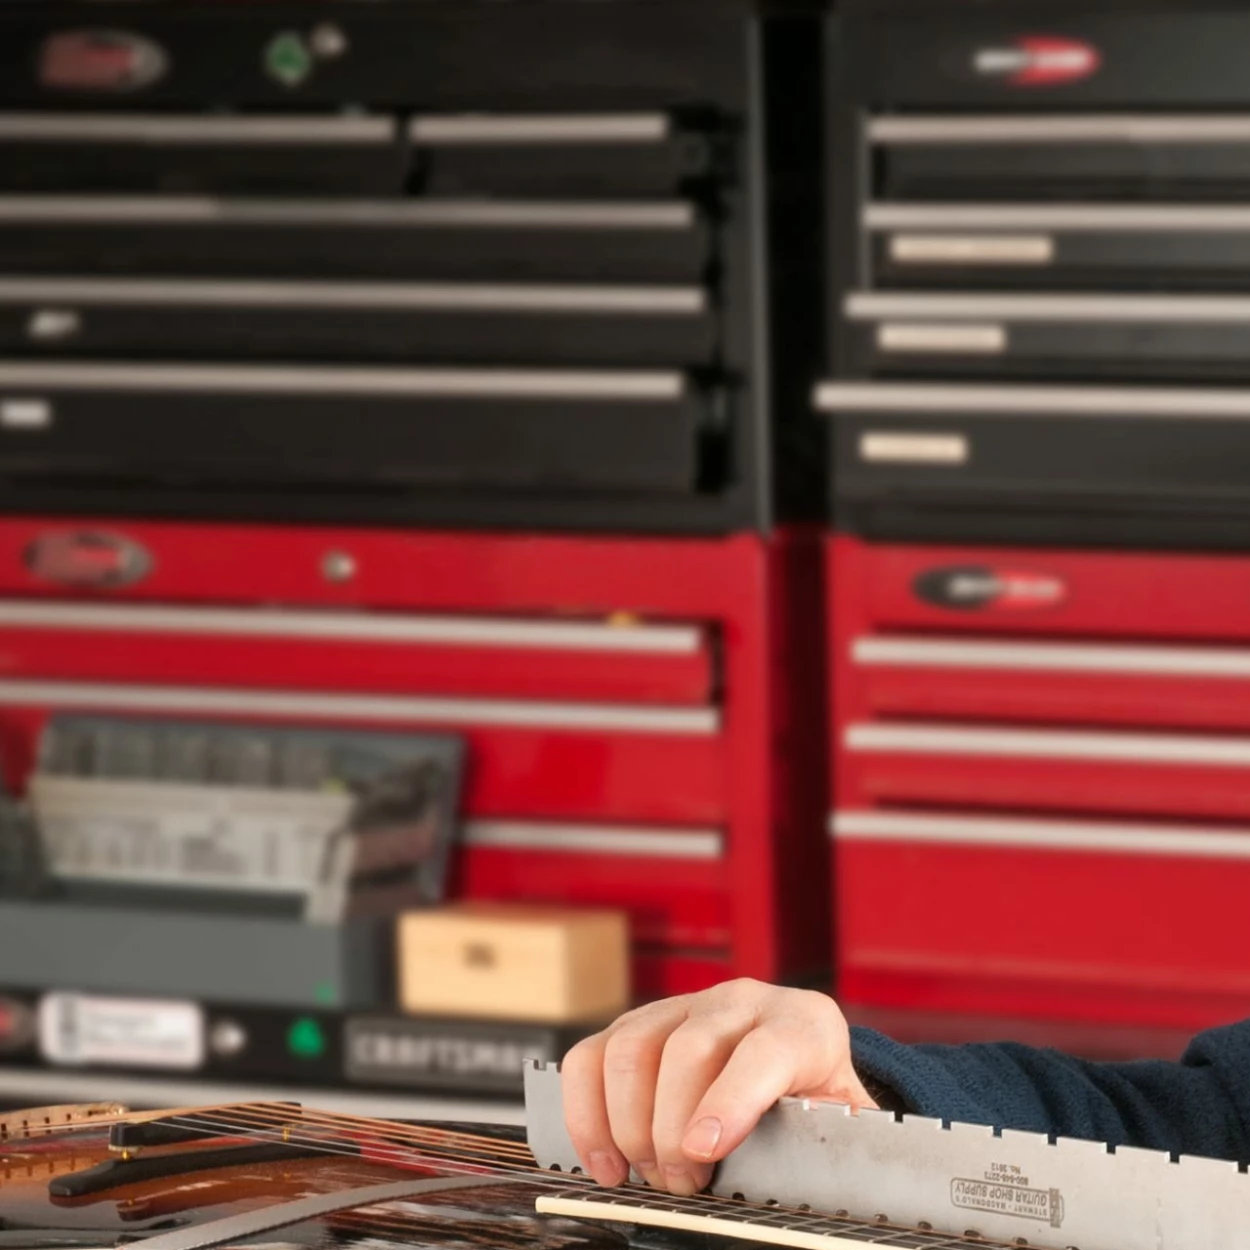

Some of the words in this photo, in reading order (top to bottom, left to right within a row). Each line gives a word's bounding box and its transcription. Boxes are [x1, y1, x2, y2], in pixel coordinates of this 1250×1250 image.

[954, 1181, 987, 1198] SUPPLY
[989, 1187, 1013, 1202] SHOP
[1015, 1189, 1047, 1207] GUITAR
